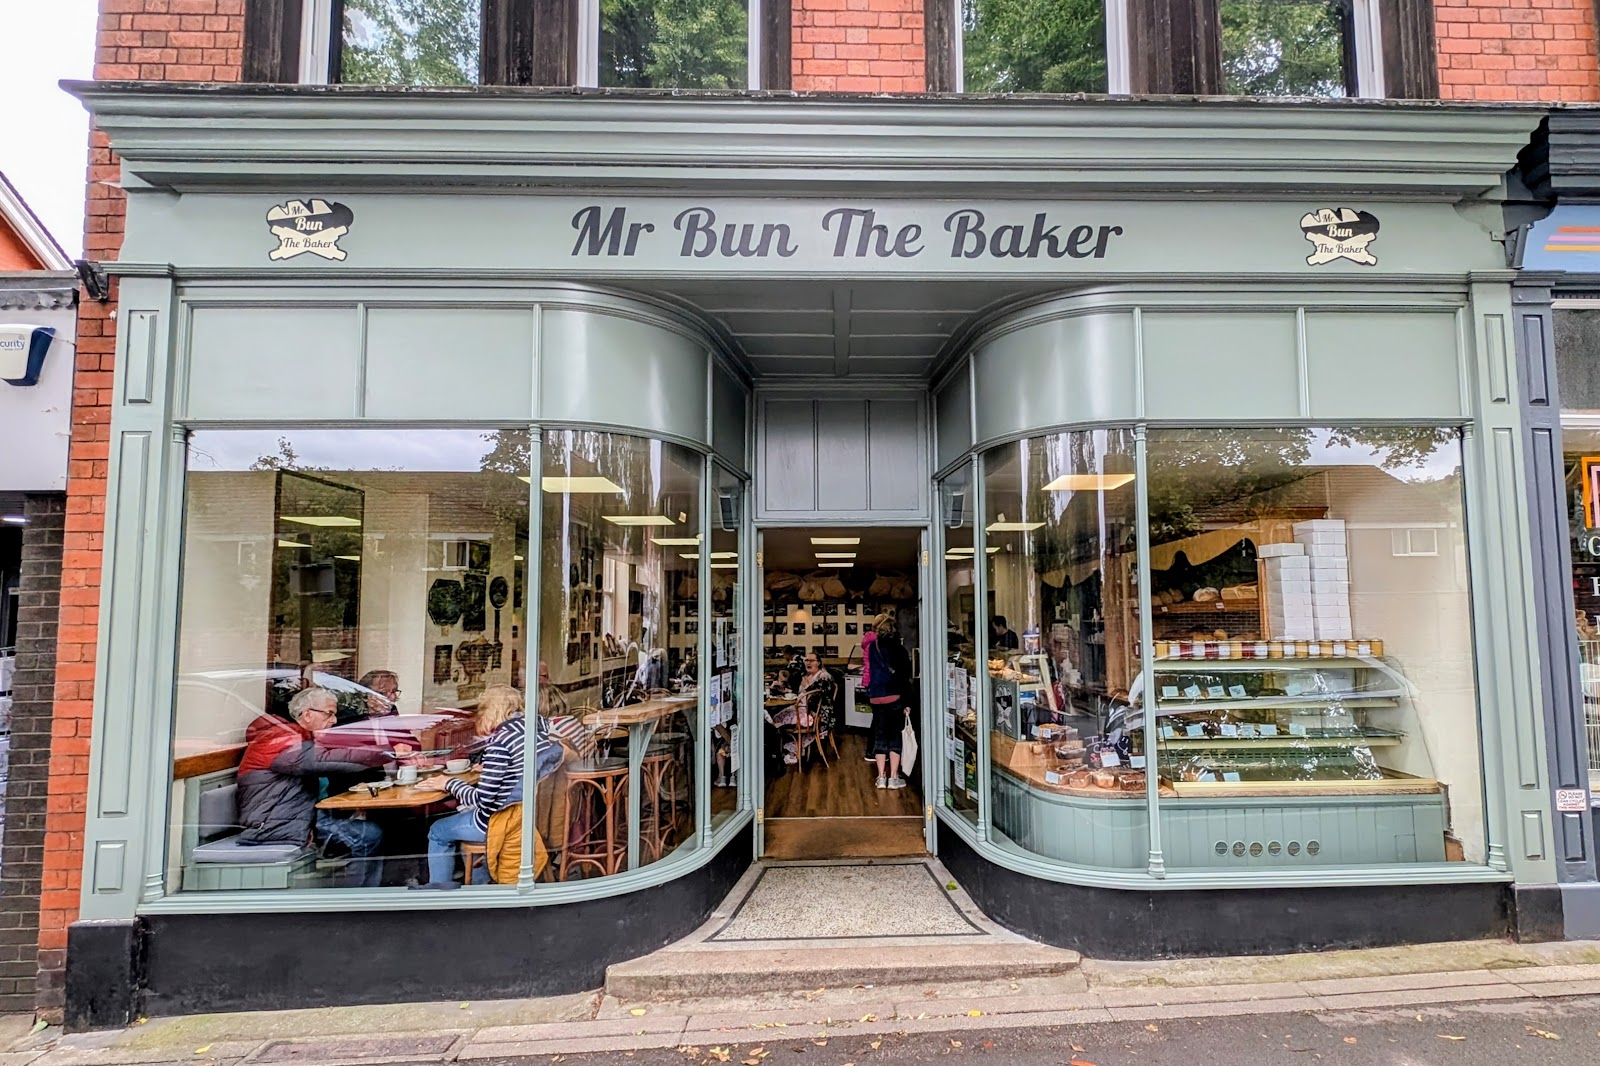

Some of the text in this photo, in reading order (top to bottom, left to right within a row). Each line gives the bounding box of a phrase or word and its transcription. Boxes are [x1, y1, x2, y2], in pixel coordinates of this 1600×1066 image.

[291, 206, 304, 215] Mr
[295, 216, 323, 230] Bun
[1322, 214, 1334, 222] Mr
[571, 205, 1124, 259] Mr Bun The Baker
[1327, 224, 1353, 237] Bun
[283, 238, 333, 248] The Baker
[1318, 244, 1363, 253] The Baker
